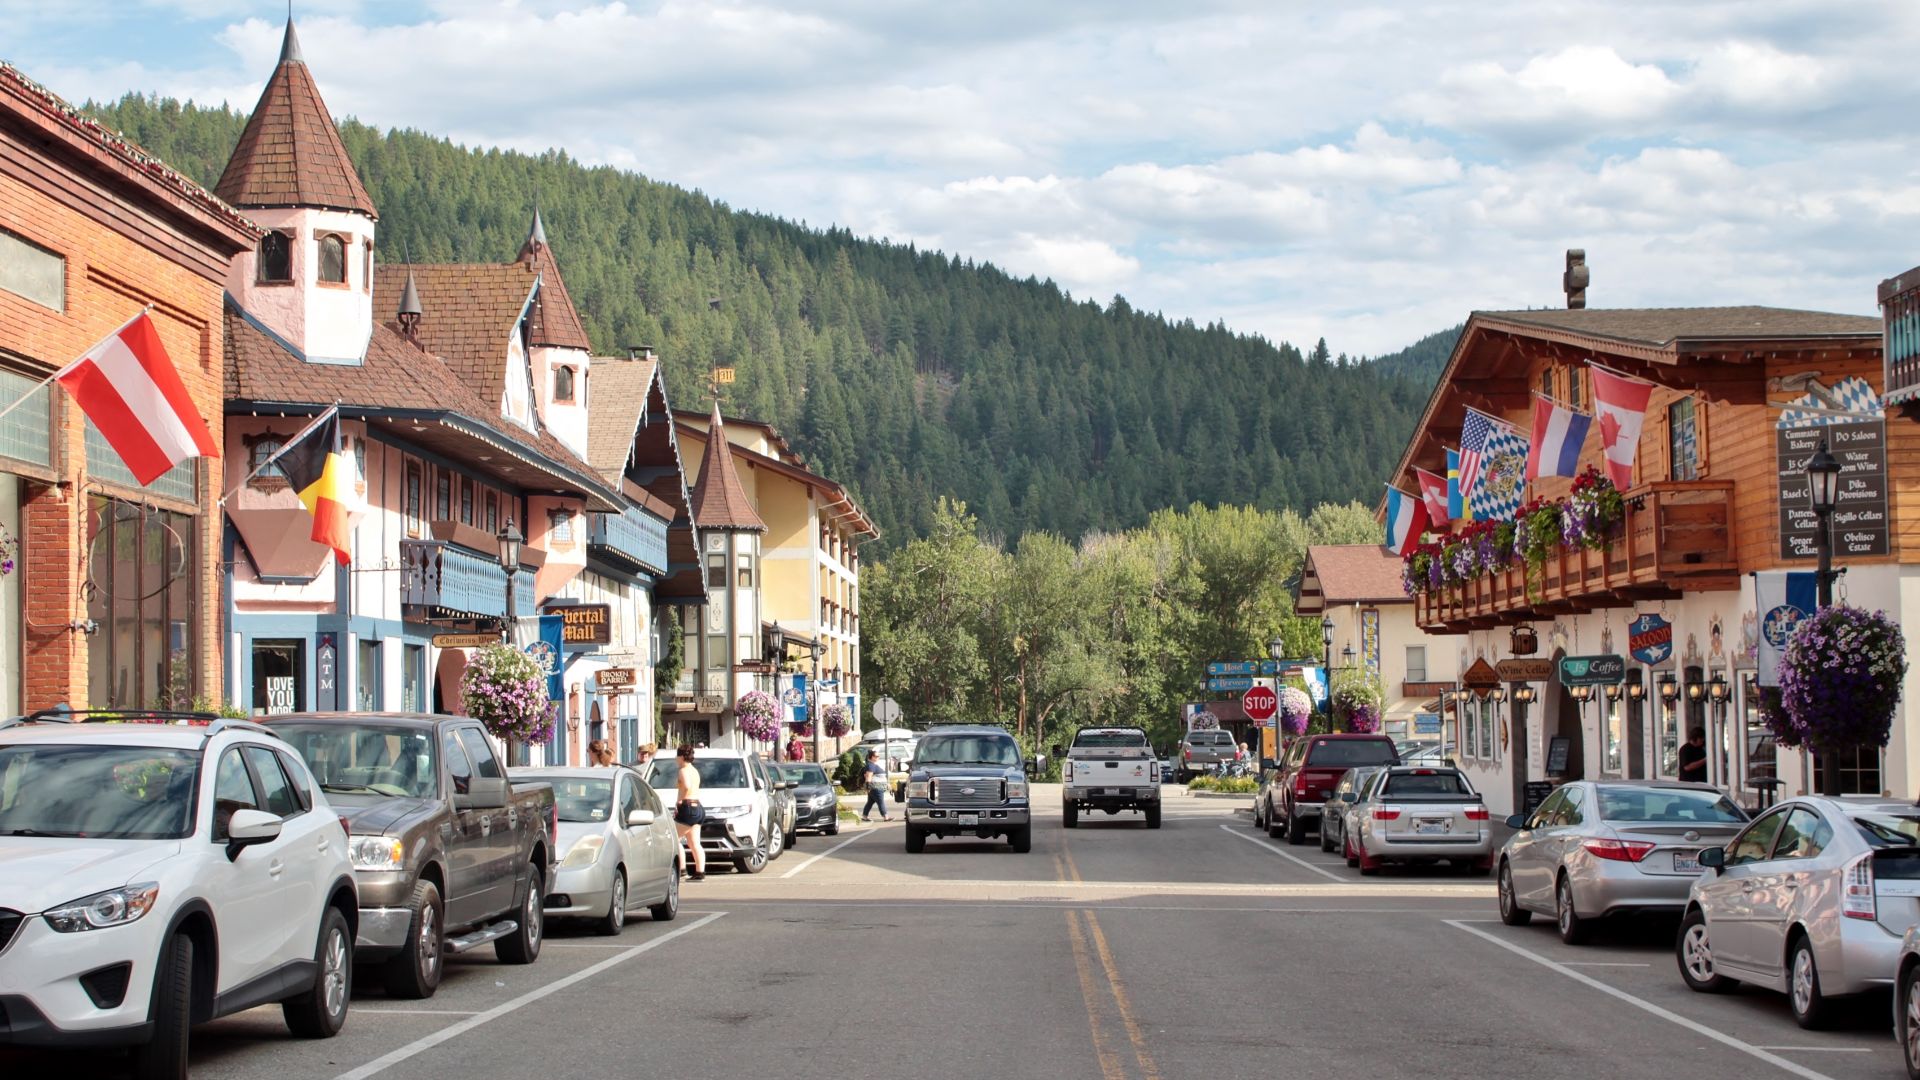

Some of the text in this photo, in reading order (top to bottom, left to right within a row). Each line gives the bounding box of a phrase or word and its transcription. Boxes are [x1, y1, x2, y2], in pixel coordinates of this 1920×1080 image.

[1835, 431, 1877, 442] PO Saloon
[1790, 440, 1815, 450] Bakery
[1845, 452, 1869, 461] Water
[1856, 461, 1878, 471] Wine
[1848, 479, 1867, 490] Pika
[1782, 489, 1801, 499] Basel
[1838, 490, 1878, 501] Provisions
[1834, 510, 1883, 524] Sigillo Cellars
[1843, 532, 1876, 543] Obelisco
[1848, 542, 1872, 552] Estate
[551, 607, 604, 624] bertal
[564, 624, 596, 640] Mall
[1631, 626, 1671, 651] SALOON
[320, 649, 334, 690] ATM
[1223, 662, 1244, 672] Hotel
[1499, 664, 1521, 675] Wine
[1589, 660, 1623, 675] Coffee
[266, 677, 295, 691] LOVE
[601, 677, 630, 685] BARREL
[267, 690, 295, 707] YOU
[701, 697, 721, 711] Posy
[1245, 696, 1276, 711] STOP
